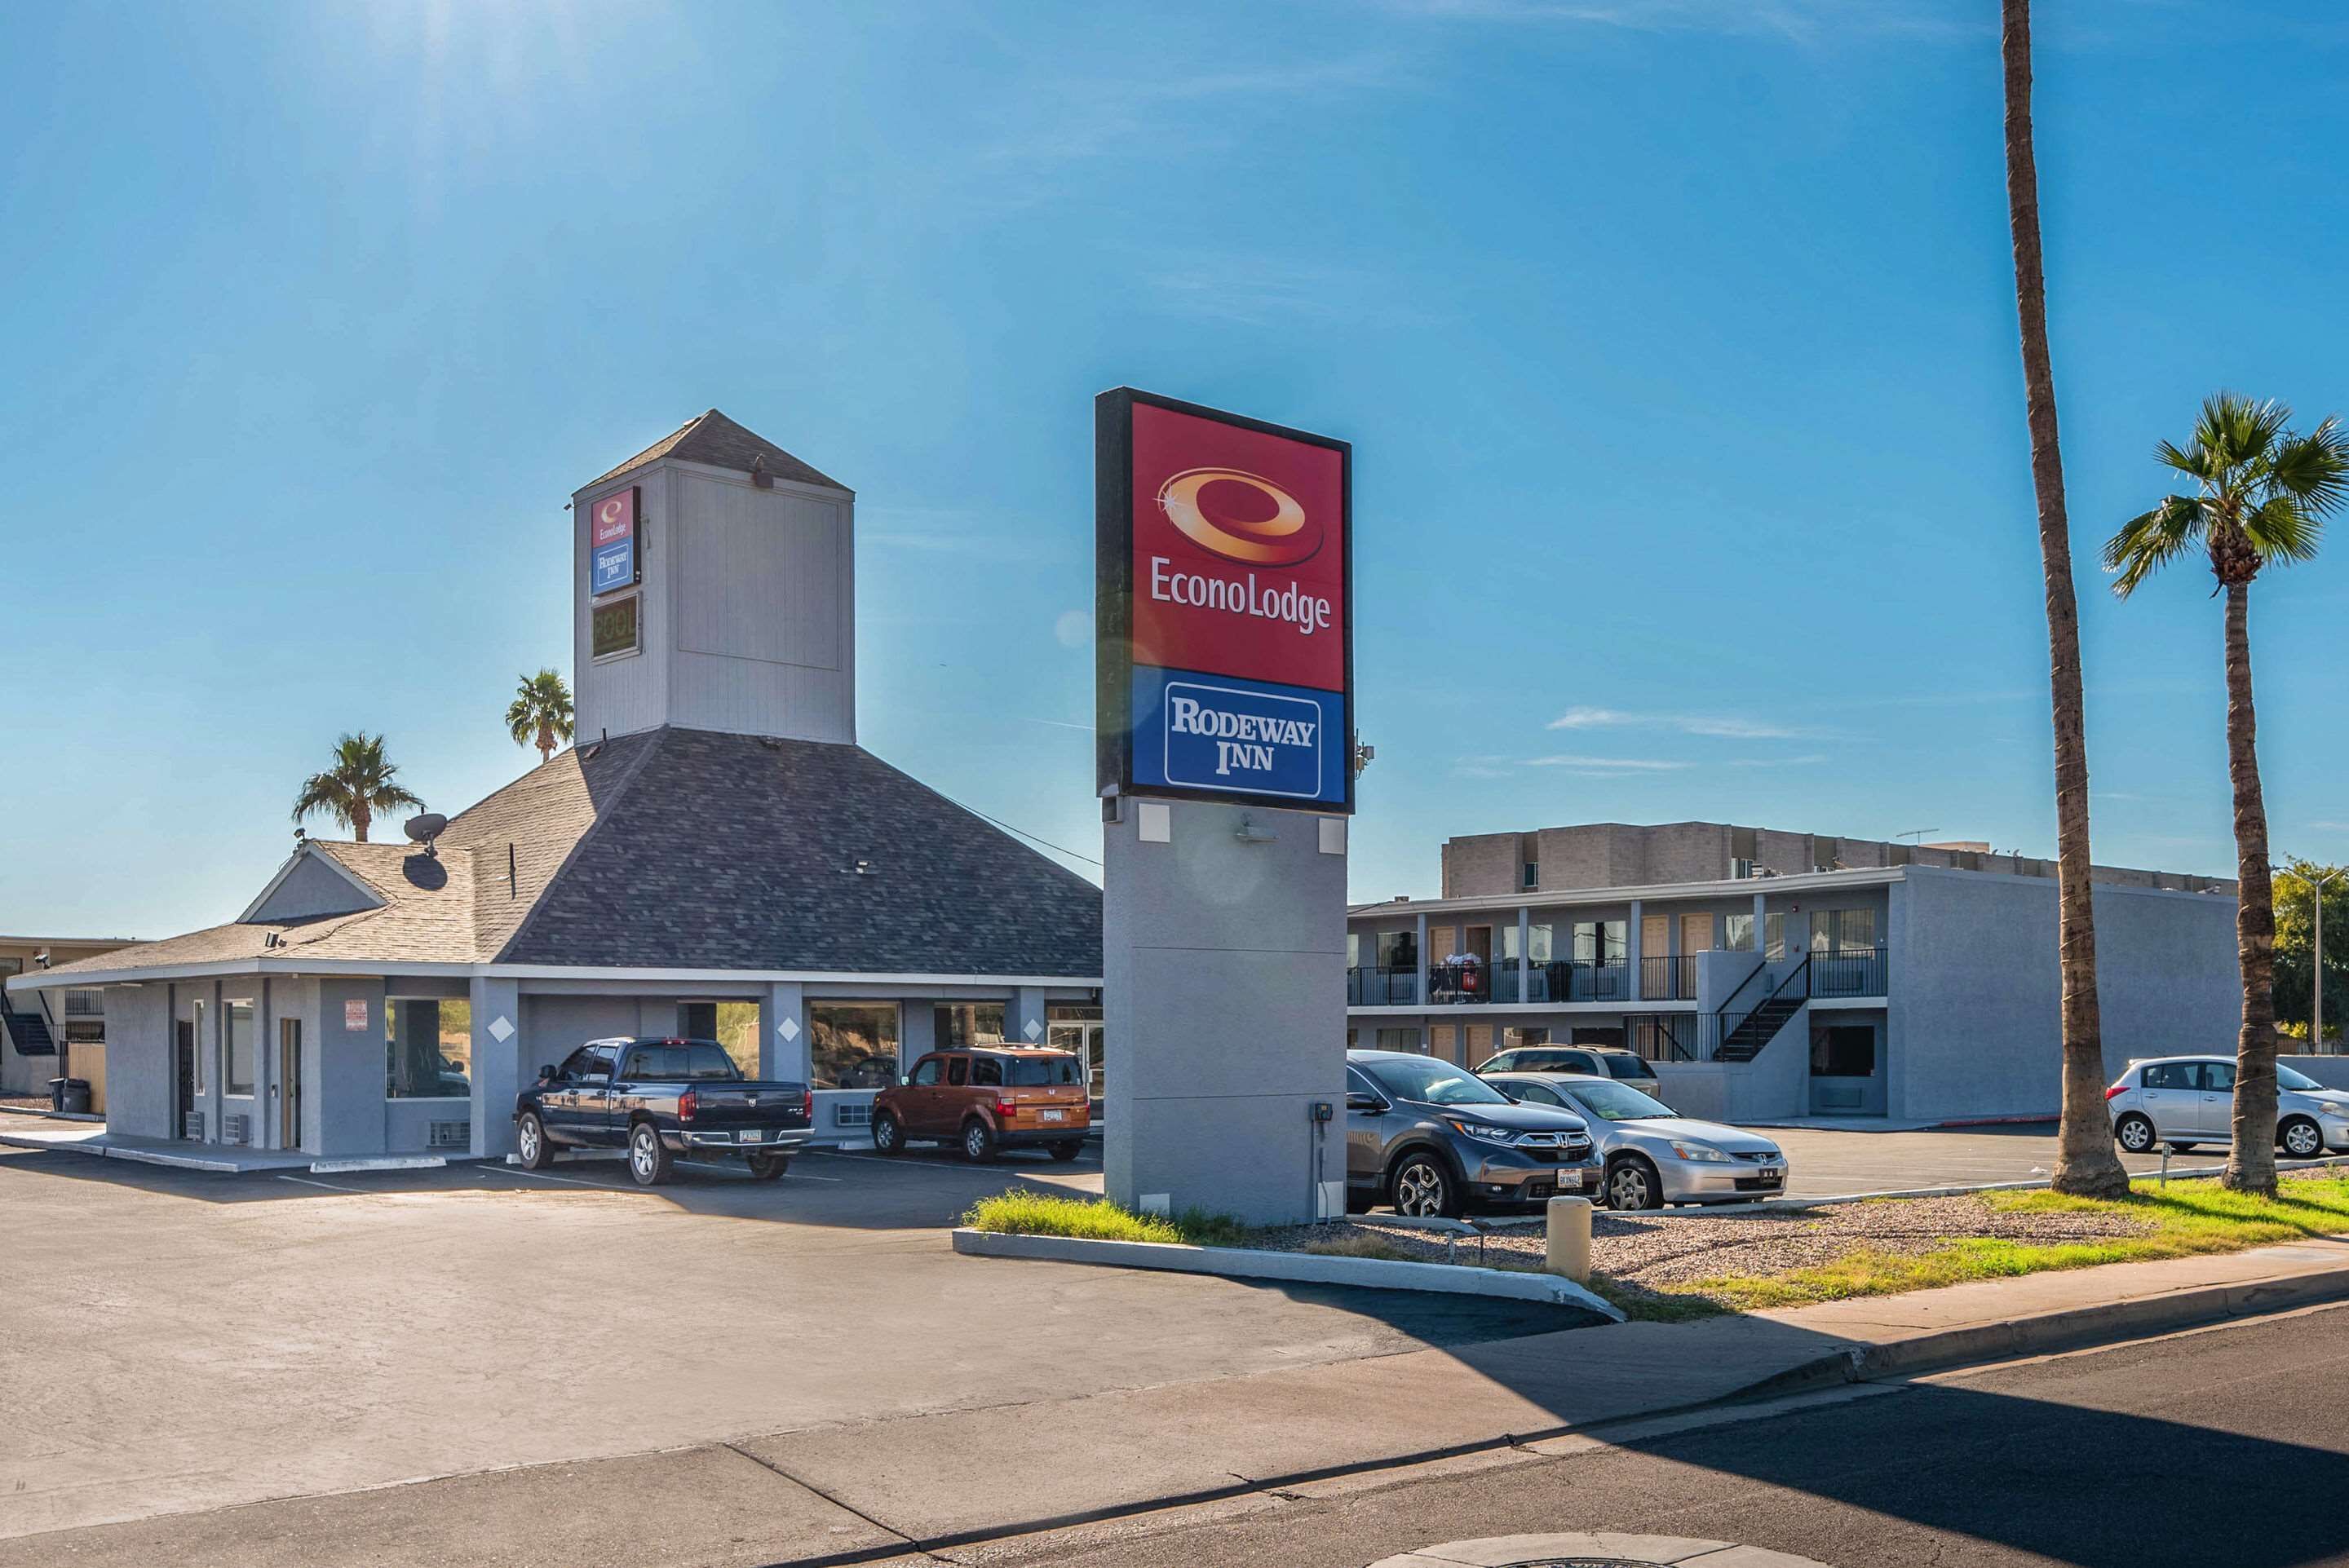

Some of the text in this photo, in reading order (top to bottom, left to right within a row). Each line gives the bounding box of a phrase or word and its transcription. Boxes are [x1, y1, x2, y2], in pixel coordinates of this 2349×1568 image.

[599, 522, 626, 541] EconoLodge
[599, 552, 627, 569] RODEWAY
[607, 564, 620, 579] INN
[1151, 556, 1331, 635] EconoLodge
[1171, 696, 1316, 748] RODEWAY
[1216, 740, 1274, 775] INN
